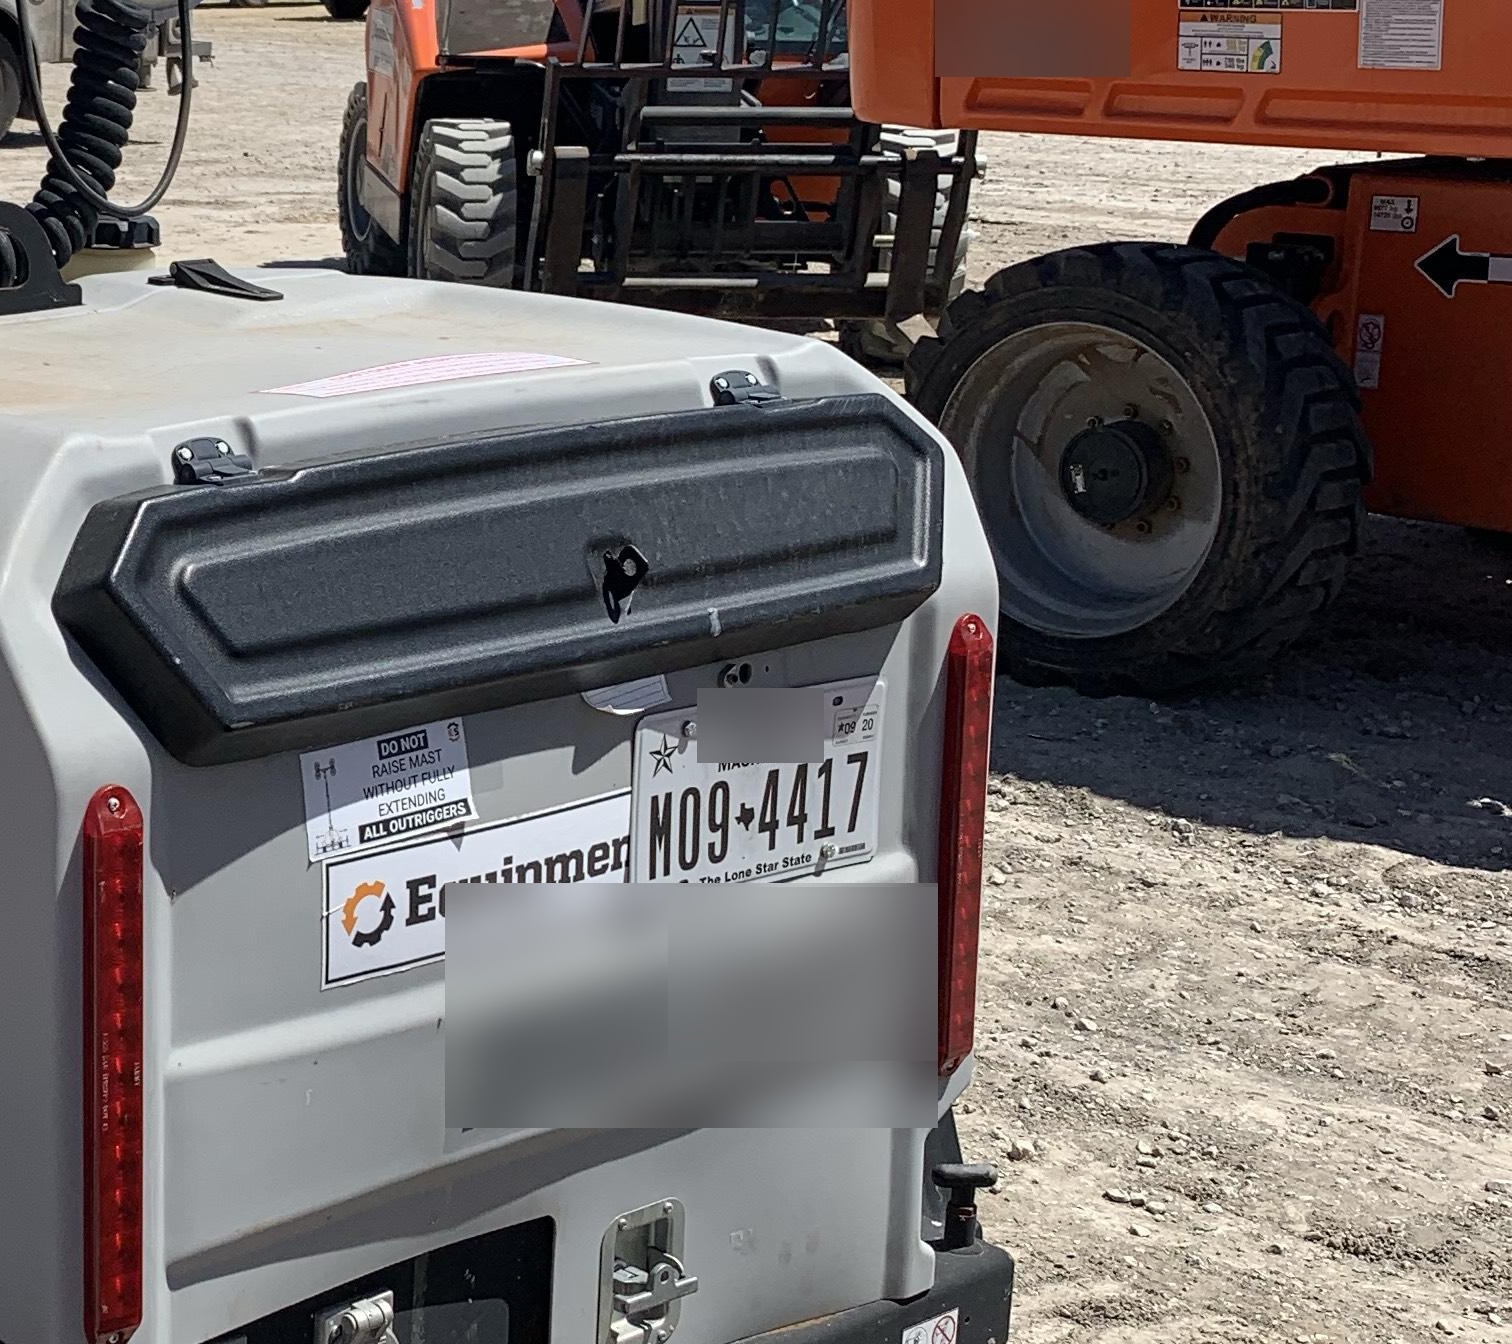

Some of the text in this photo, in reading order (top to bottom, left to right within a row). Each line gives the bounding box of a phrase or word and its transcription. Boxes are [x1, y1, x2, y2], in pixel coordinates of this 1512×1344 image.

[1209, 13, 1257, 24] WARNING
[862, 718, 874, 732] 20
[381, 732, 426, 755] DO NOT
[372, 749, 442, 778] RAISE MAST
[363, 765, 455, 800] WITHOUT FULLY
[378, 788, 446, 816] EXTENDING
[363, 802, 467, 840] ALL OUTRIGGERS
[725, 868, 752, 882] Lone
[755, 861, 779, 875] Star
[782, 854, 813, 868] State
